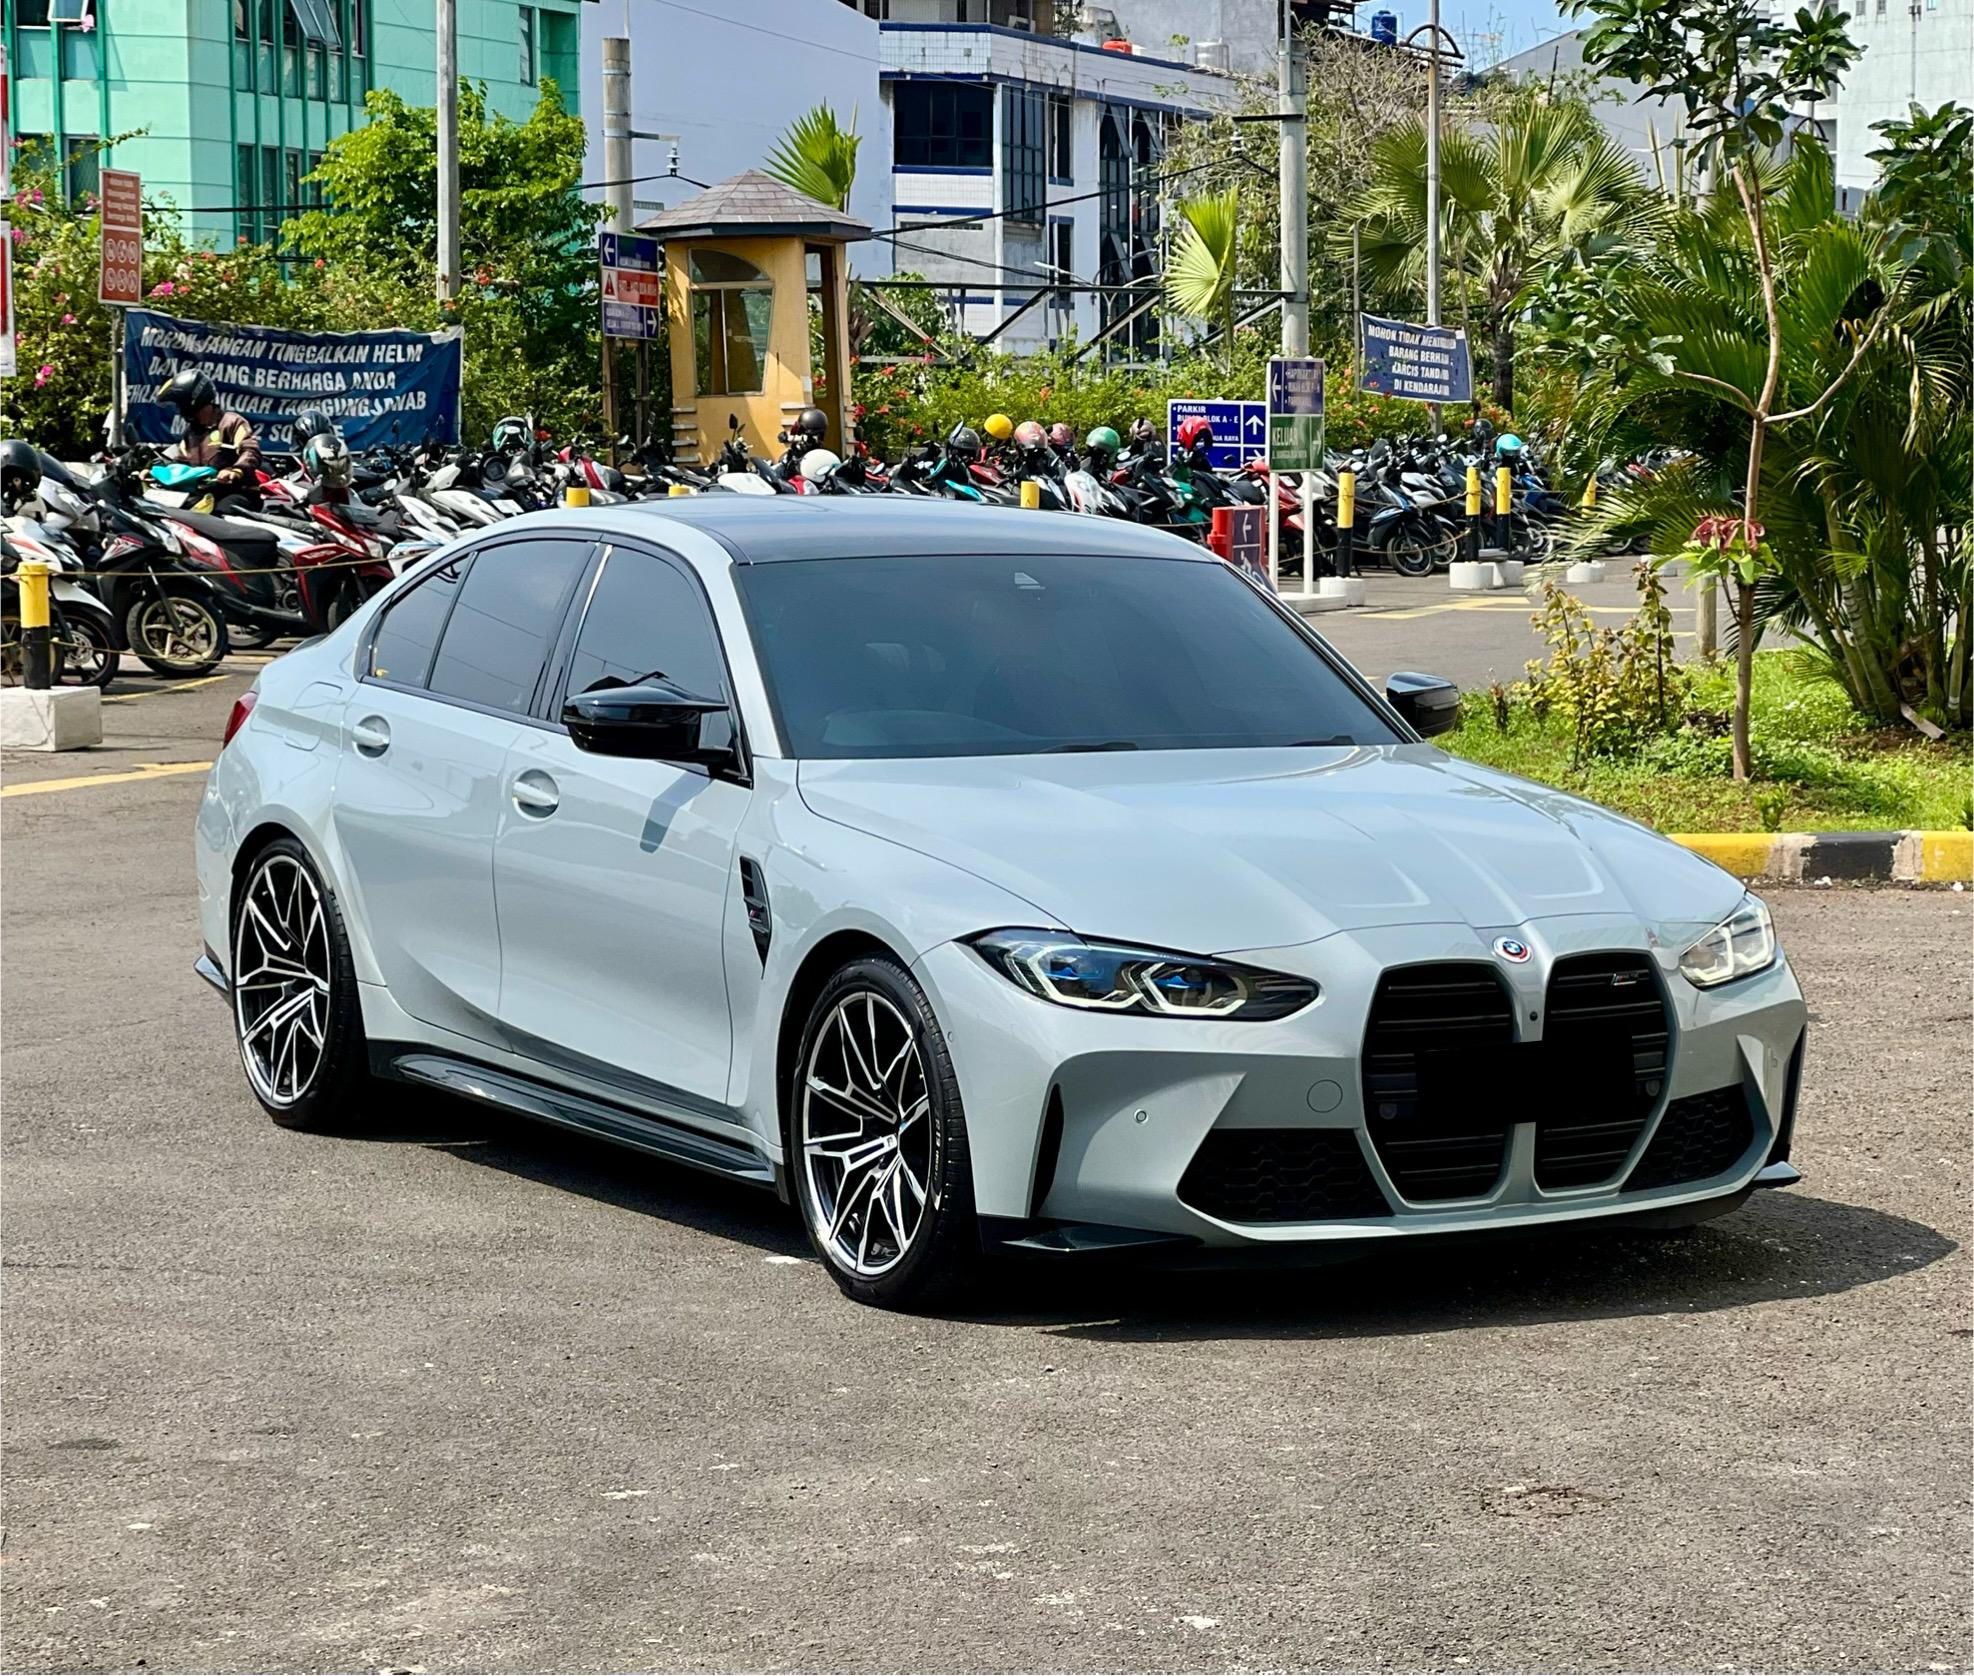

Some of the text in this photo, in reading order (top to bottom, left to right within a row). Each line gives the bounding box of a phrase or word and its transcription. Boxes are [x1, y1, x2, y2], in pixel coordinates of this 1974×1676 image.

[1368, 325, 1397, 341] MOHON
[1398, 331, 1421, 345] TIDAK
[198, 334, 268, 358] JANGAN
[268, 342, 369, 364] TINGGALKAN
[372, 344, 424, 363] HELM
[1389, 345, 1419, 361] BARANG
[254, 367, 348, 391] BERHARGA
[351, 371, 396, 390] ANDA
[1394, 379, 1402, 390] DI
[1177, 405, 1206, 414] PARKIR
[1222, 416, 1228, 424] A
[1234, 416, 1239, 424] E
